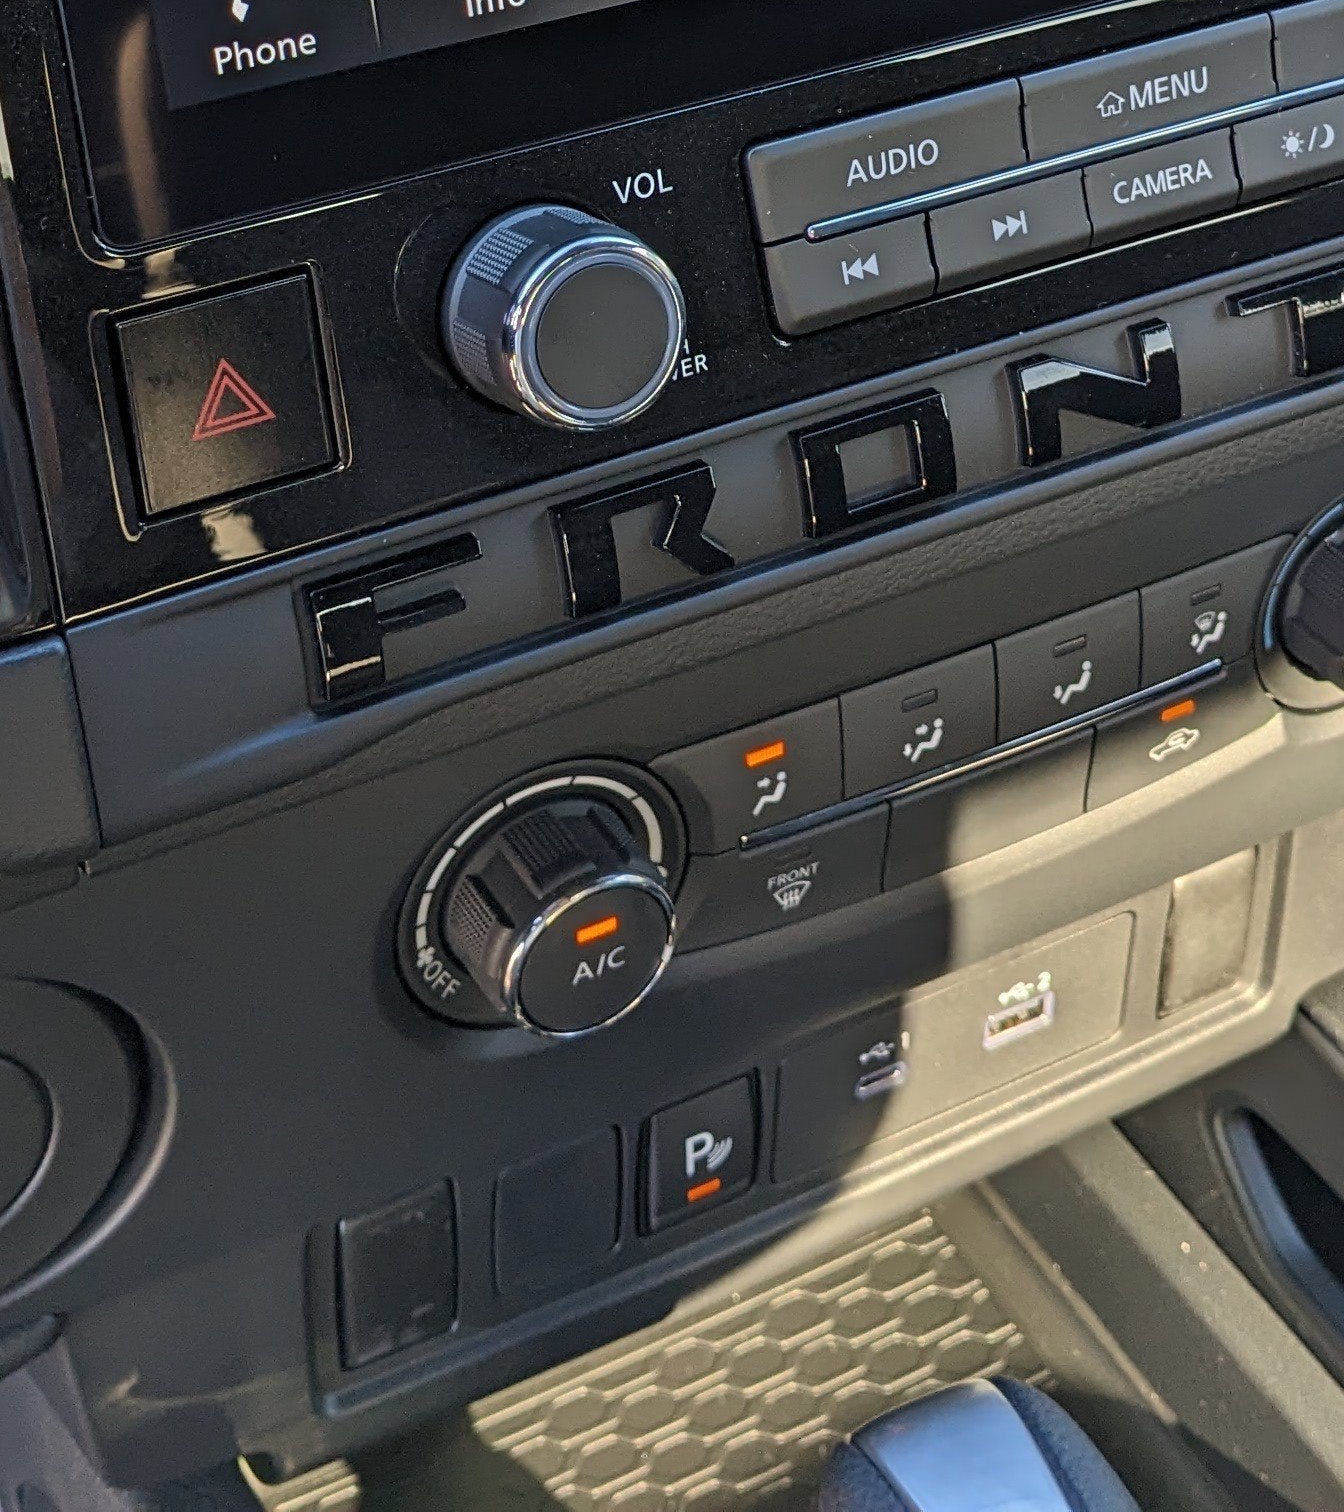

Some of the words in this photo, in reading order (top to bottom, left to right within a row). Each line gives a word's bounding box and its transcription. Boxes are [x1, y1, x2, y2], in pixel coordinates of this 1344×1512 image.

[213, 32, 317, 76] Phone
[1128, 67, 1209, 112] MENU
[845, 138, 940, 188] AUDIO
[1111, 159, 1213, 207] CAMERA
[612, 169, 674, 204] VOL
[767, 861, 819, 888] FRONT
[422, 958, 461, 1001] OFF
[572, 945, 627, 986] A/C
[685, 1132, 713, 1177] P
